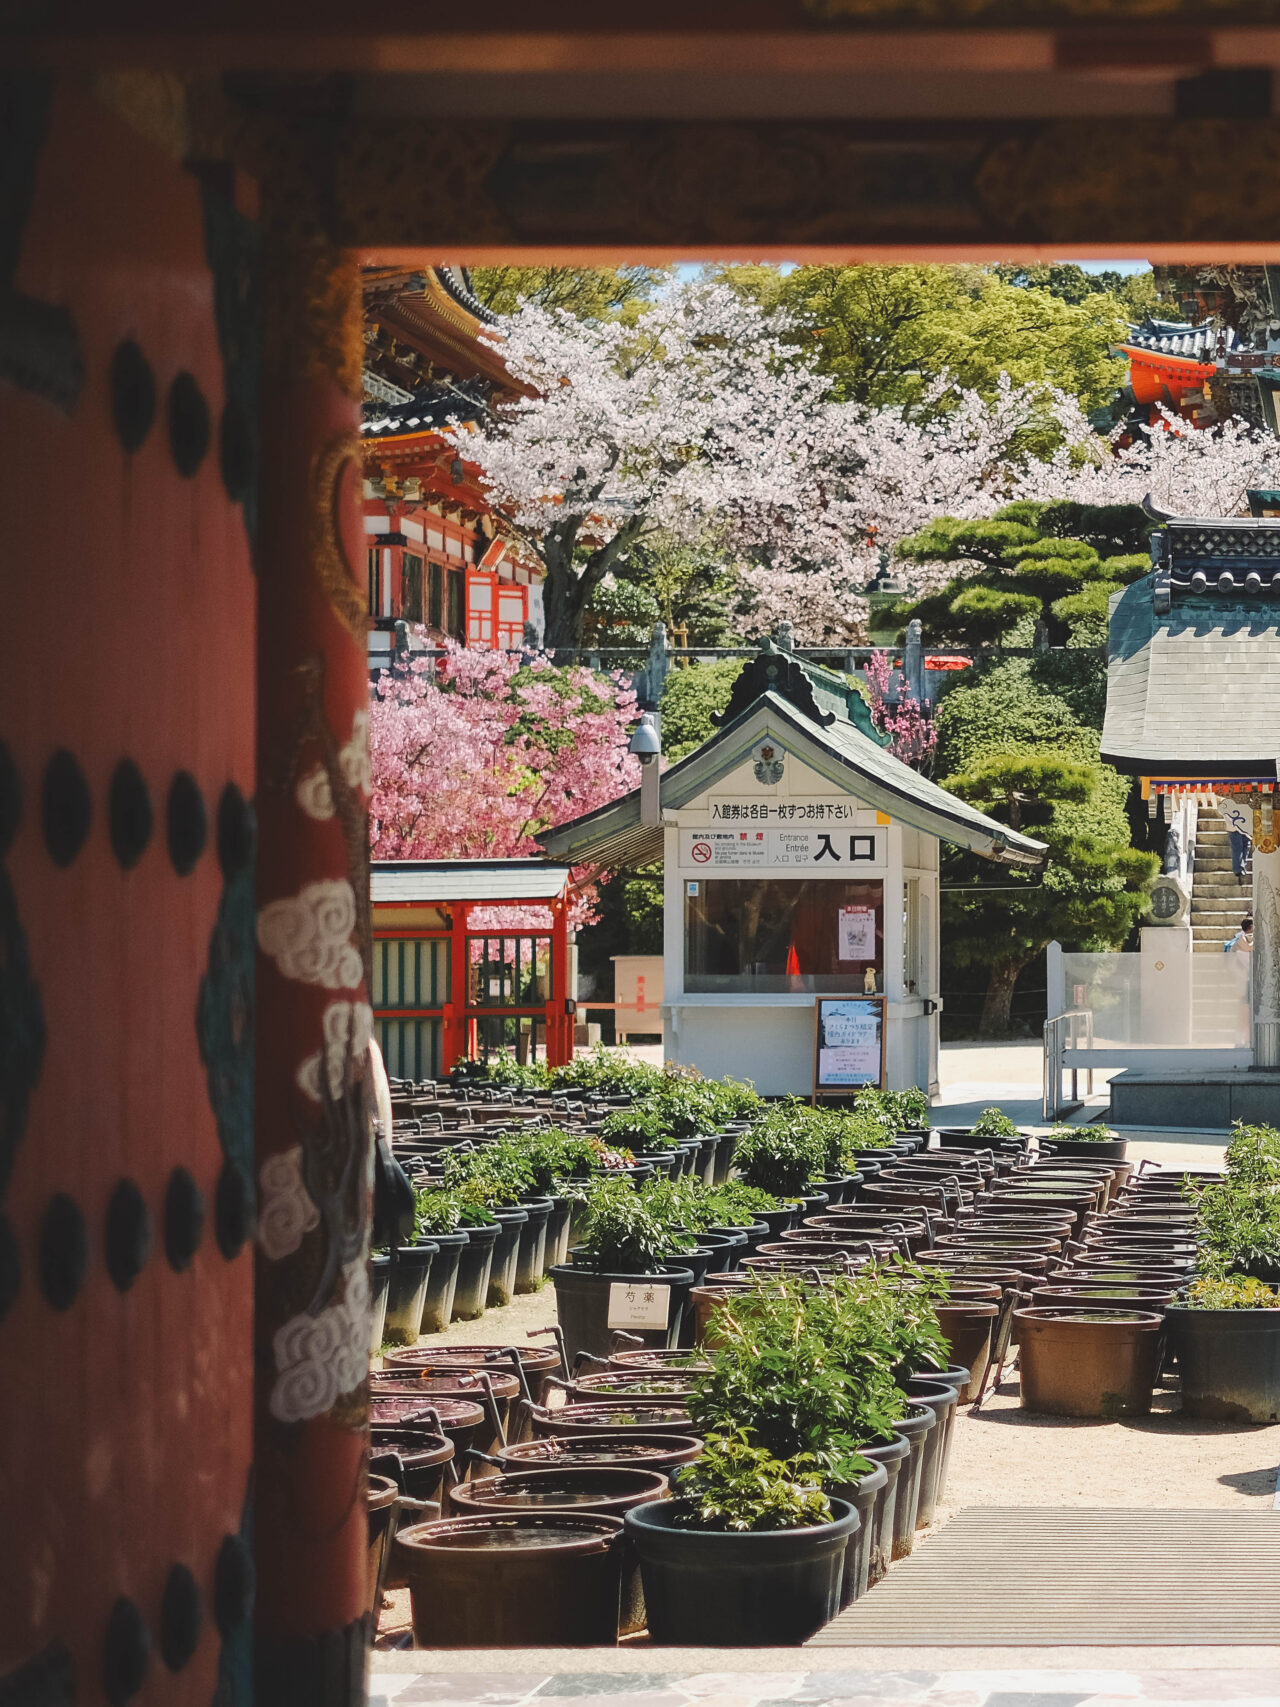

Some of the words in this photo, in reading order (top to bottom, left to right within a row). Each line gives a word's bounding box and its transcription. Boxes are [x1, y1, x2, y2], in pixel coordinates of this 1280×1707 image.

[712, 804, 853, 819] 入館券は各自一枚ずつお持下さい
[779, 833, 809, 842] Entrance
[785, 843, 809, 852] Entrée
[813, 834, 875, 861] 入口
